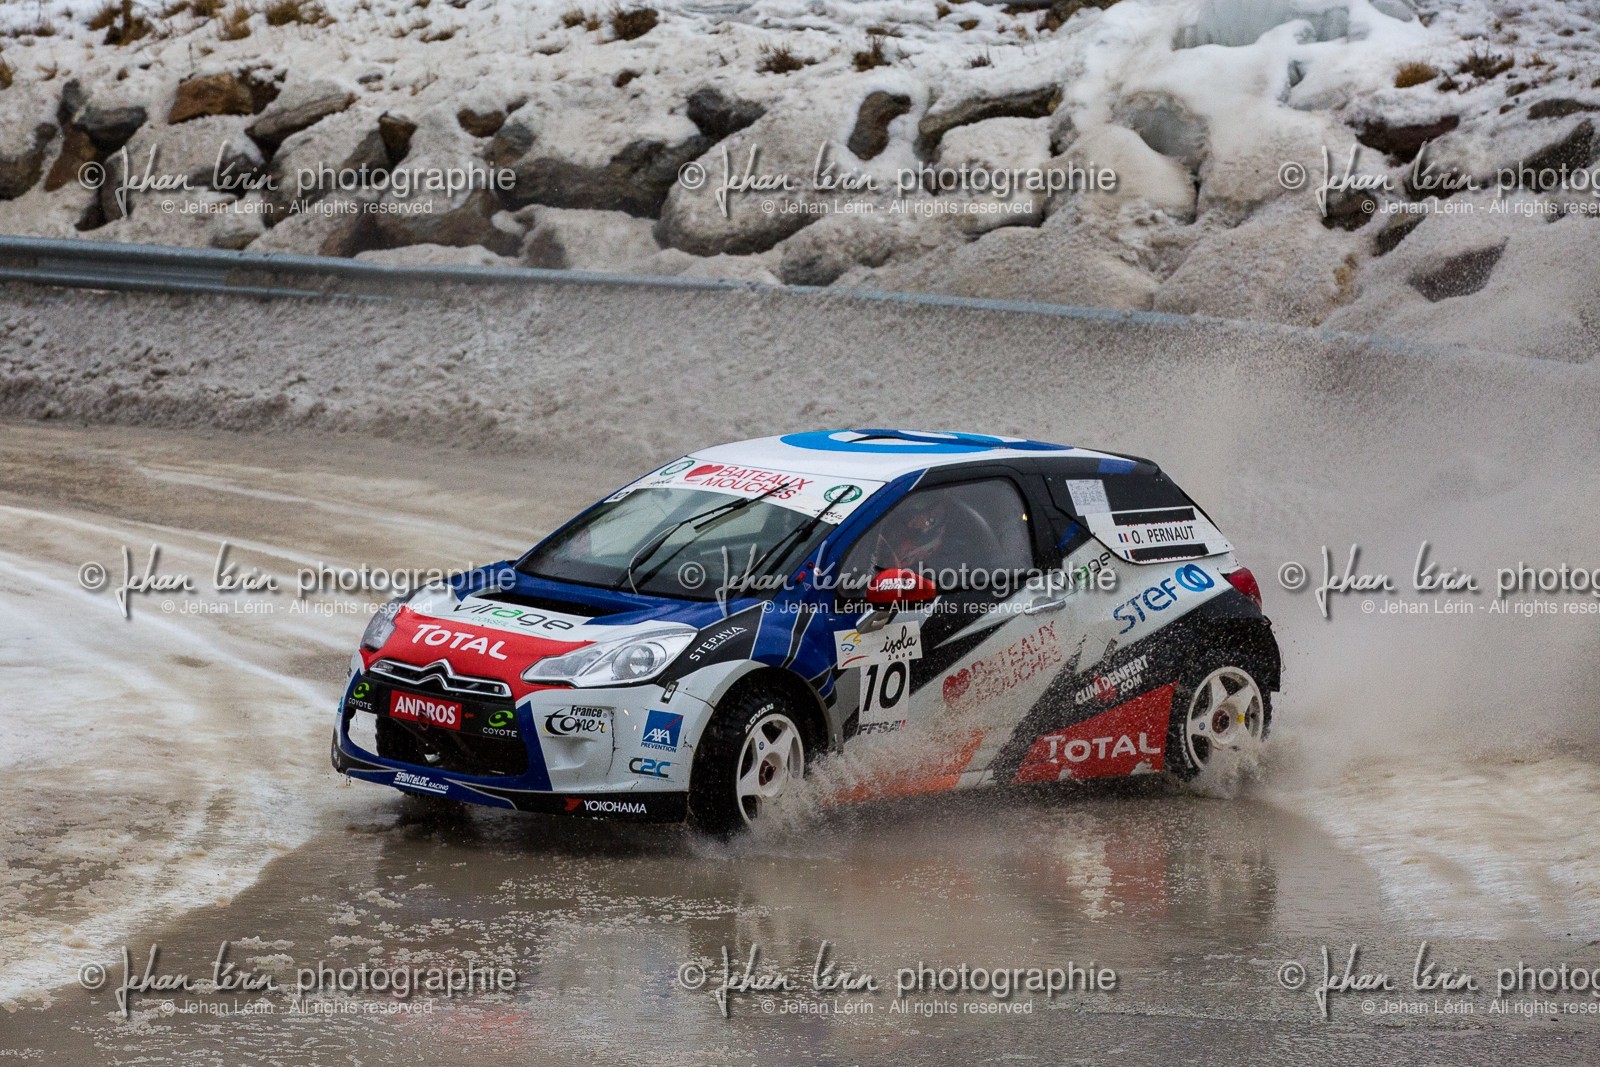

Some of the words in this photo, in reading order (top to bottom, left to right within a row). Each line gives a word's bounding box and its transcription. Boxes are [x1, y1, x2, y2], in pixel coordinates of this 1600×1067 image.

[716, 466, 814, 490] BATEAUX
[1131, 529, 1144, 545] O.
[1147, 525, 1195, 543] PERNAUT
[453, 603, 574, 631] virage
[411, 623, 508, 660] TOTAL
[690, 626, 745, 661] STEPHYA
[880, 625, 918, 654] isola
[863, 660, 907, 712] 10
[348, 697, 372, 710] COYOTE
[394, 695, 456, 725] ANDROS
[569, 704, 602, 718] France
[482, 726, 518, 738] COYOTE
[643, 727, 671, 745] AXA
[1044, 732, 1161, 764] TOTAL
[628, 757, 671, 779] C2C
[428, 781, 449, 791] RACING
[584, 800, 648, 814] YOKOHAMA
